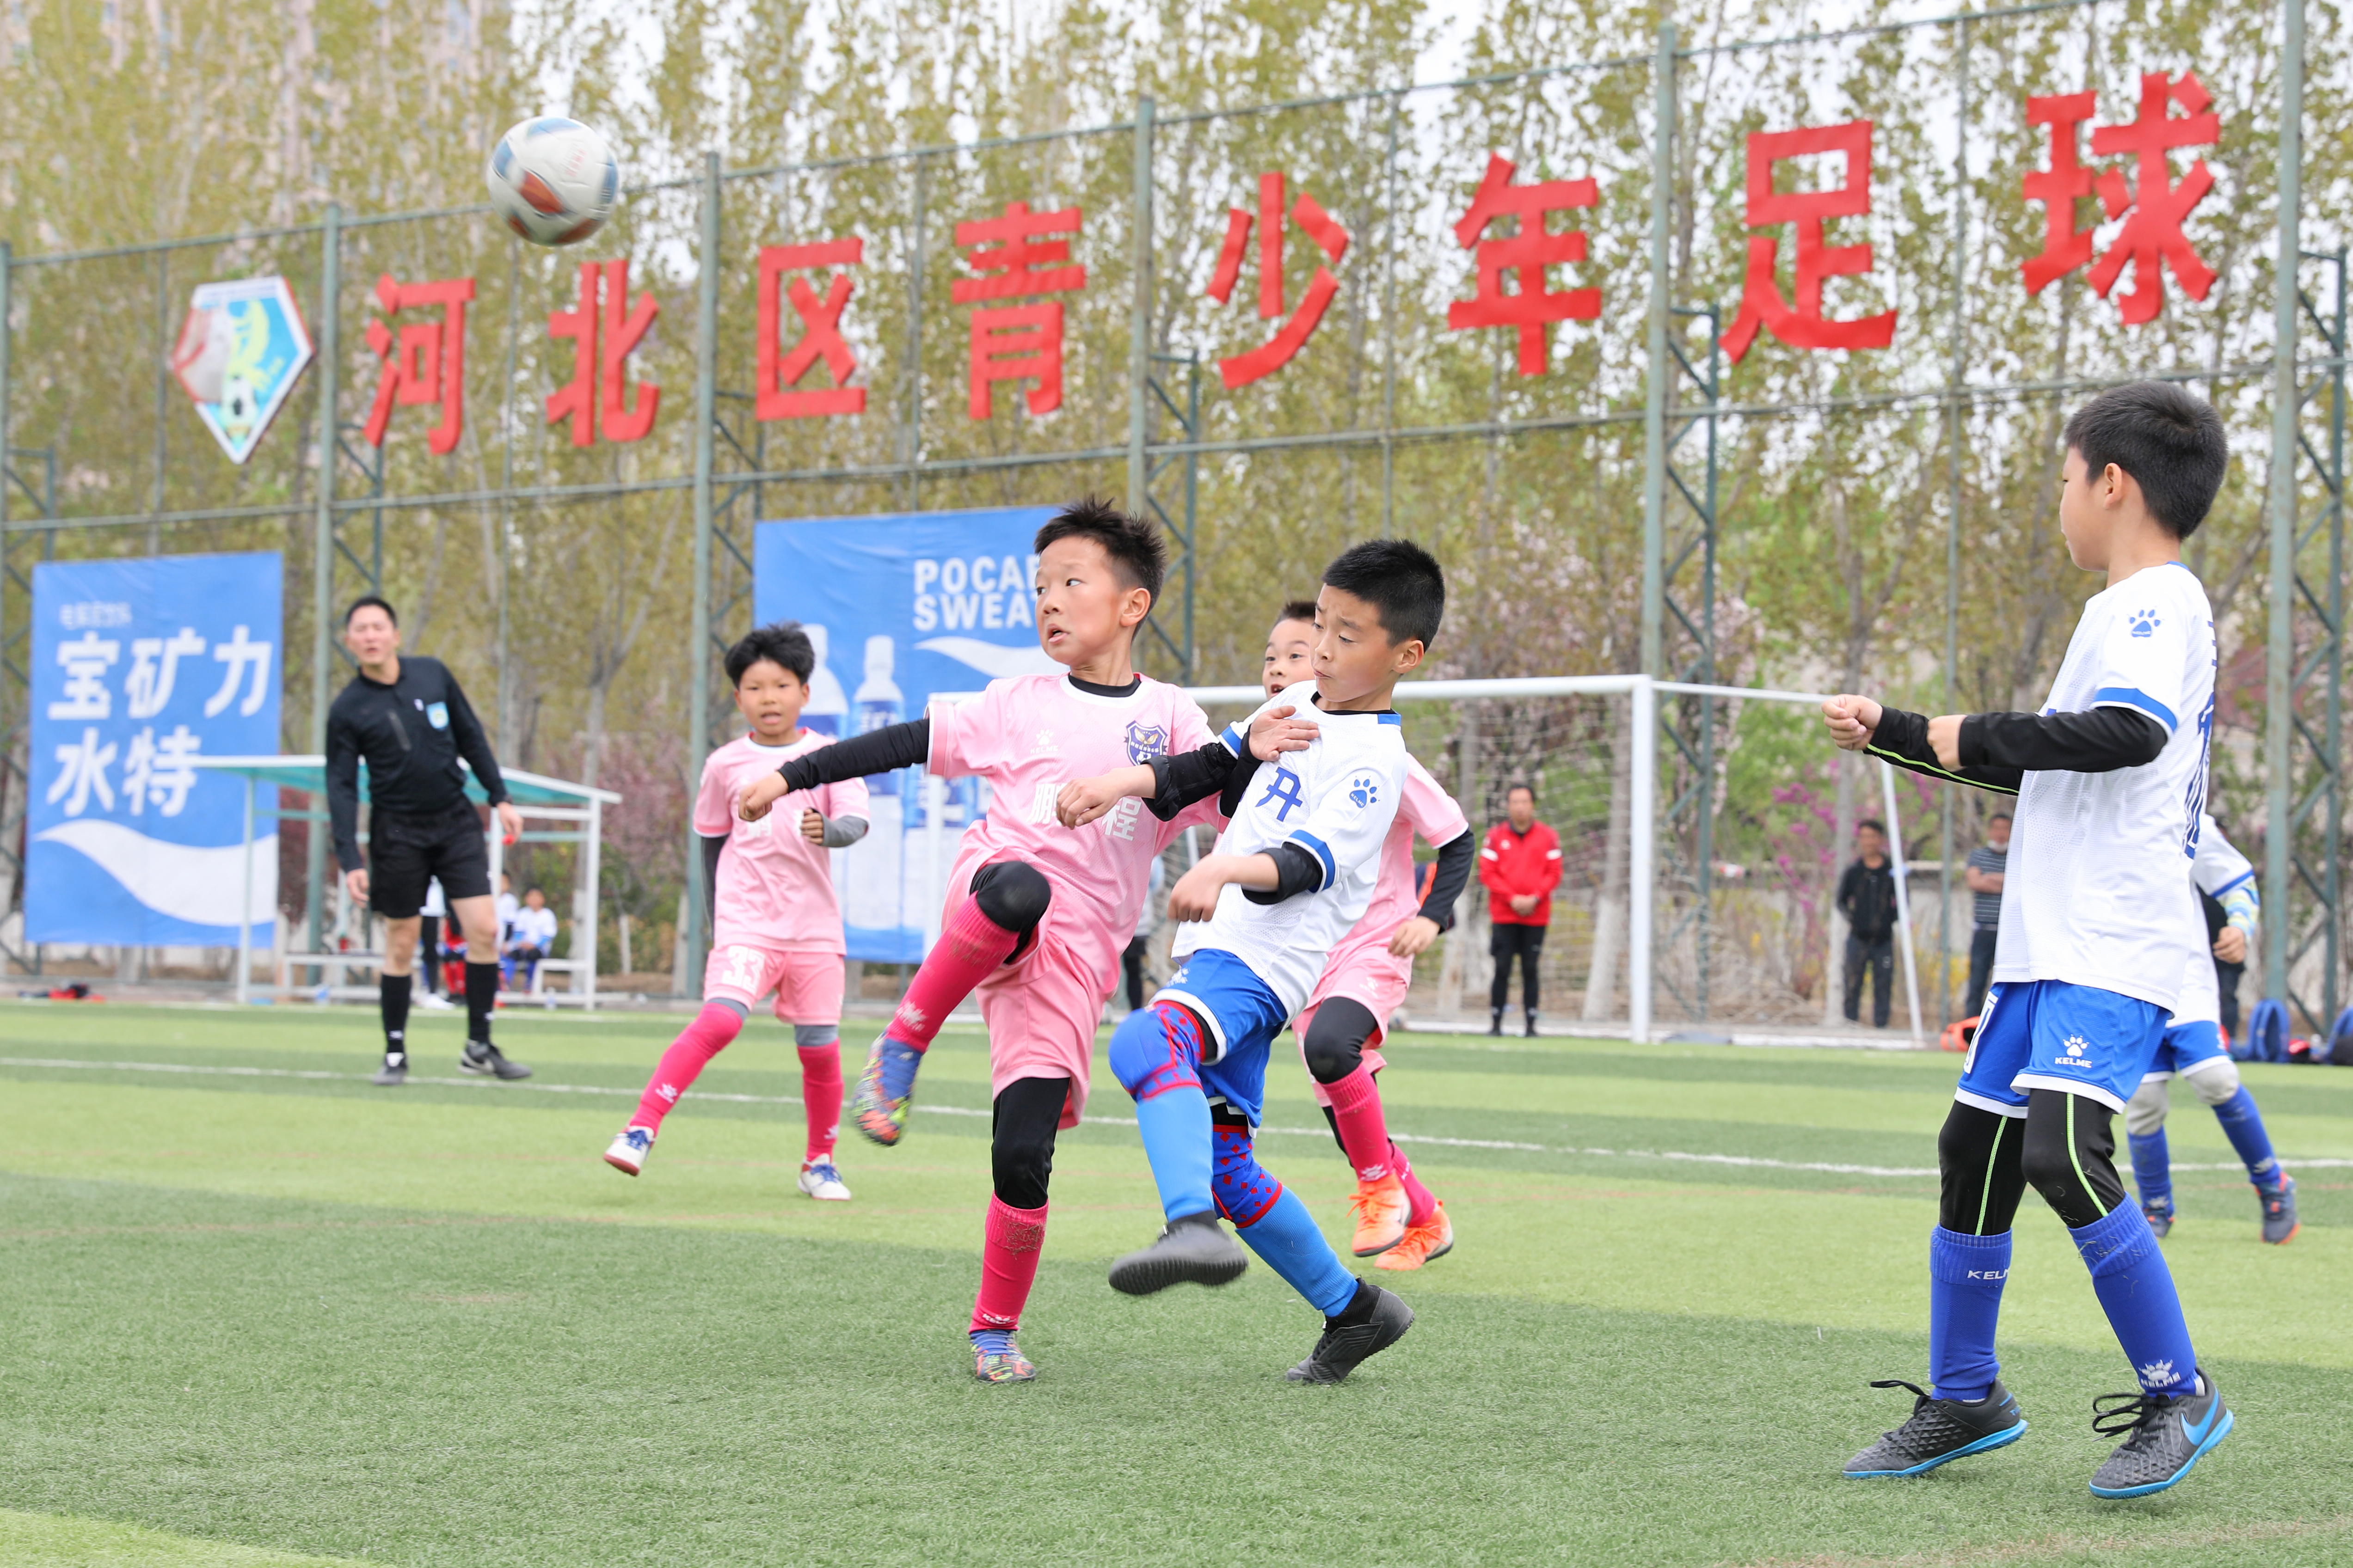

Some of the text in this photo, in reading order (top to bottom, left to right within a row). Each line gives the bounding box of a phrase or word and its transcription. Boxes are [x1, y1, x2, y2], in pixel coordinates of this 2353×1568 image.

[363, 72, 2221, 455] 河北区青少年足球
[913, 593, 1038, 631] SWEA
[47, 625, 274, 720] 宝矿力
[46, 726, 202, 817] 水特
[1030, 745, 1059, 755] KELME
[1351, 792, 1364, 807] KELME
[721, 945, 766, 996] 33
[2054, 1057, 2093, 1068] KELME
